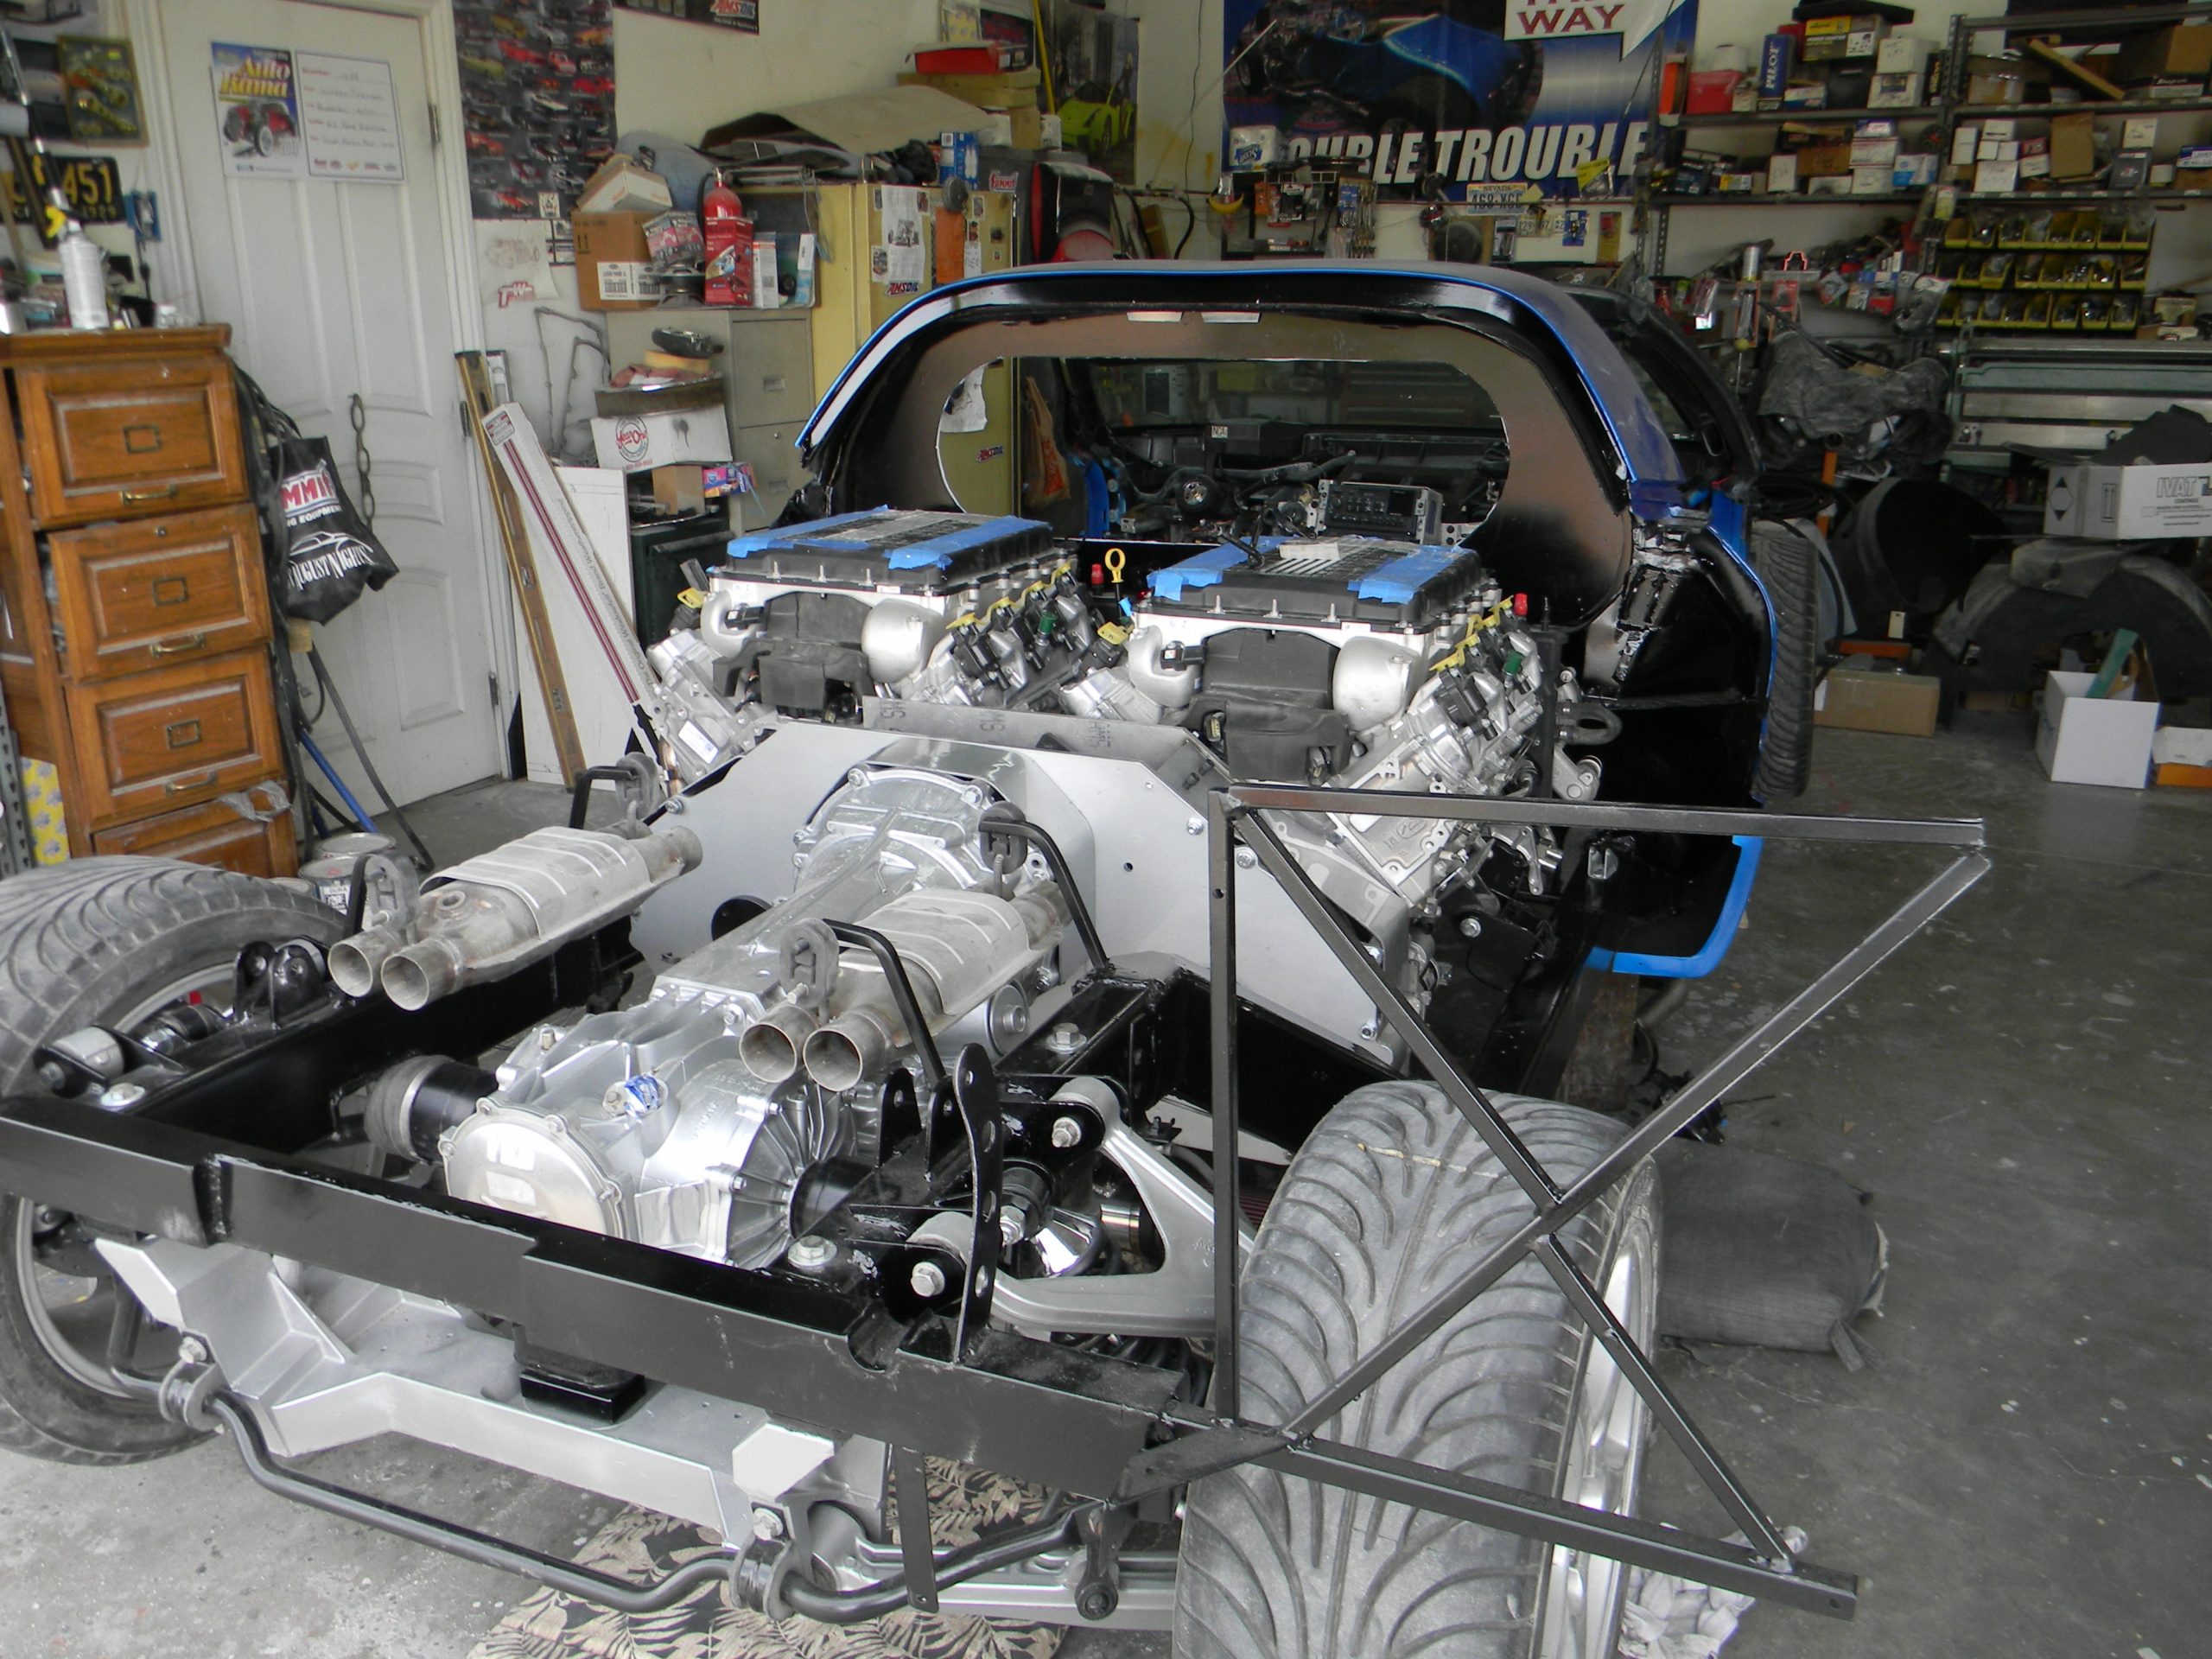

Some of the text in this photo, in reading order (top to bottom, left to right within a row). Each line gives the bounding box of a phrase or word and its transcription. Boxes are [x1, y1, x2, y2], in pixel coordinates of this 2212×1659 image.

[1517, 4, 1624, 35] WAY
[1765, 41, 1780, 90] PILOT
[888, 283, 918, 295] AMSOIL
[294, 556, 331, 591] AUGUST
